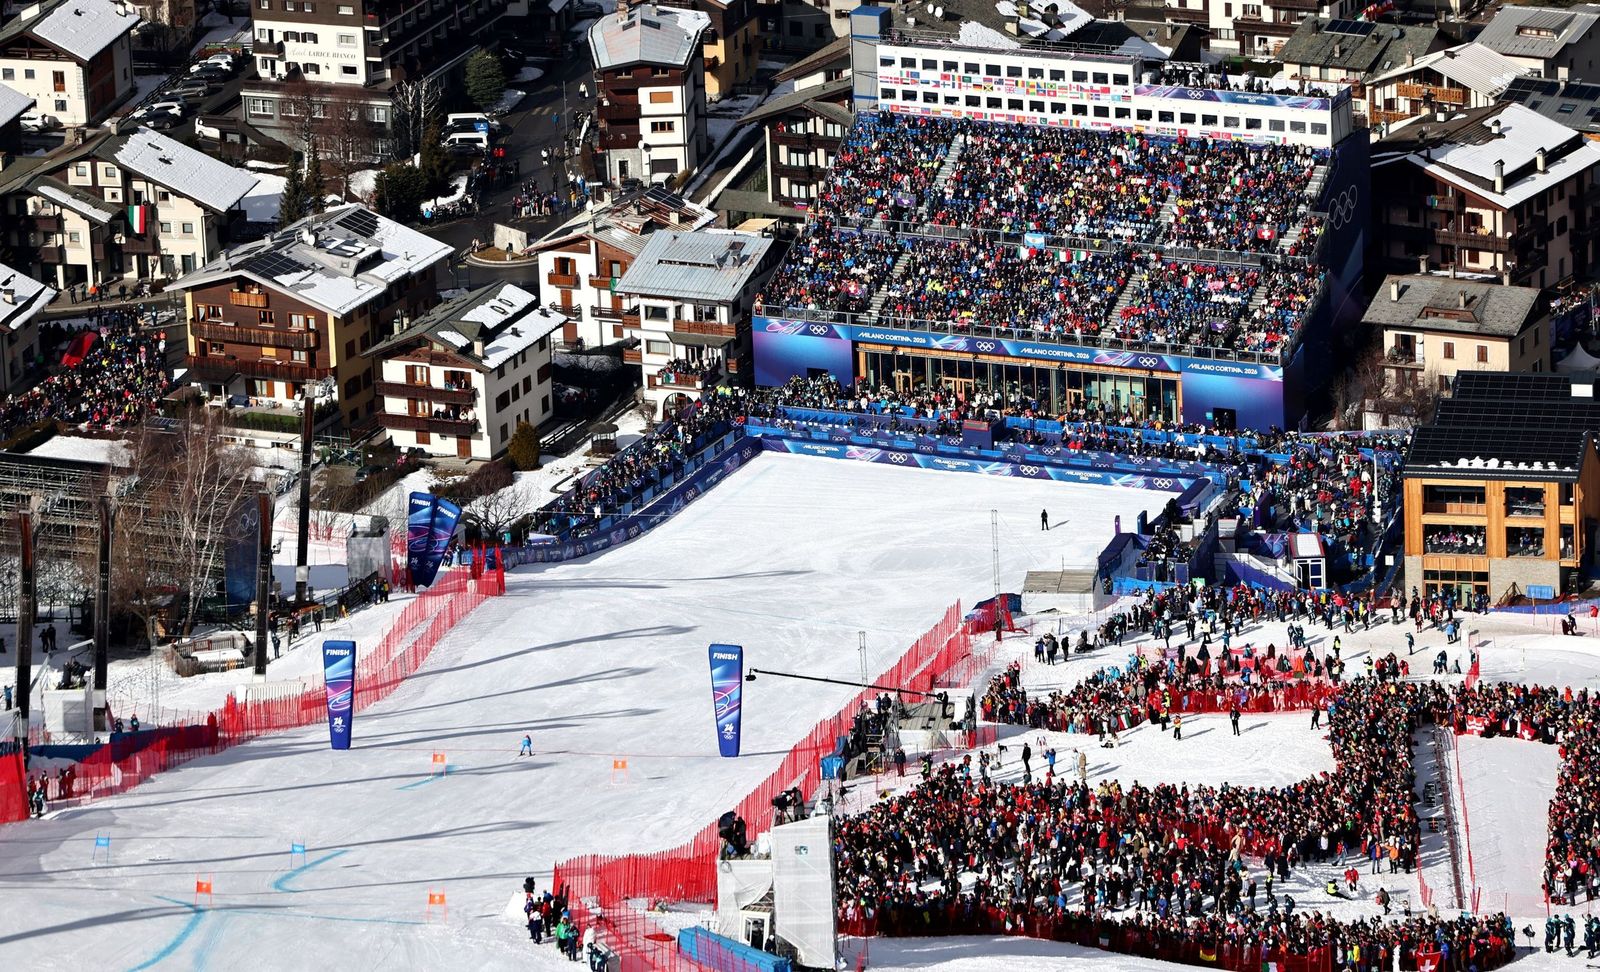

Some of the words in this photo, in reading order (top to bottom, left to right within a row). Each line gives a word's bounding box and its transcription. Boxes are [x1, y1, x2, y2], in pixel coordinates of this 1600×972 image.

[858, 332, 884, 340] MILANO
[884, 334, 912, 342] CORTINA
[1020, 348, 1047, 356] MILANO
[1048, 350, 1076, 358] CORTINA
[1215, 365, 1243, 374] CORTINA
[411, 498, 430, 507] FINISH
[437, 506, 457, 520] FINISH
[713, 652, 738, 661] FINISH
